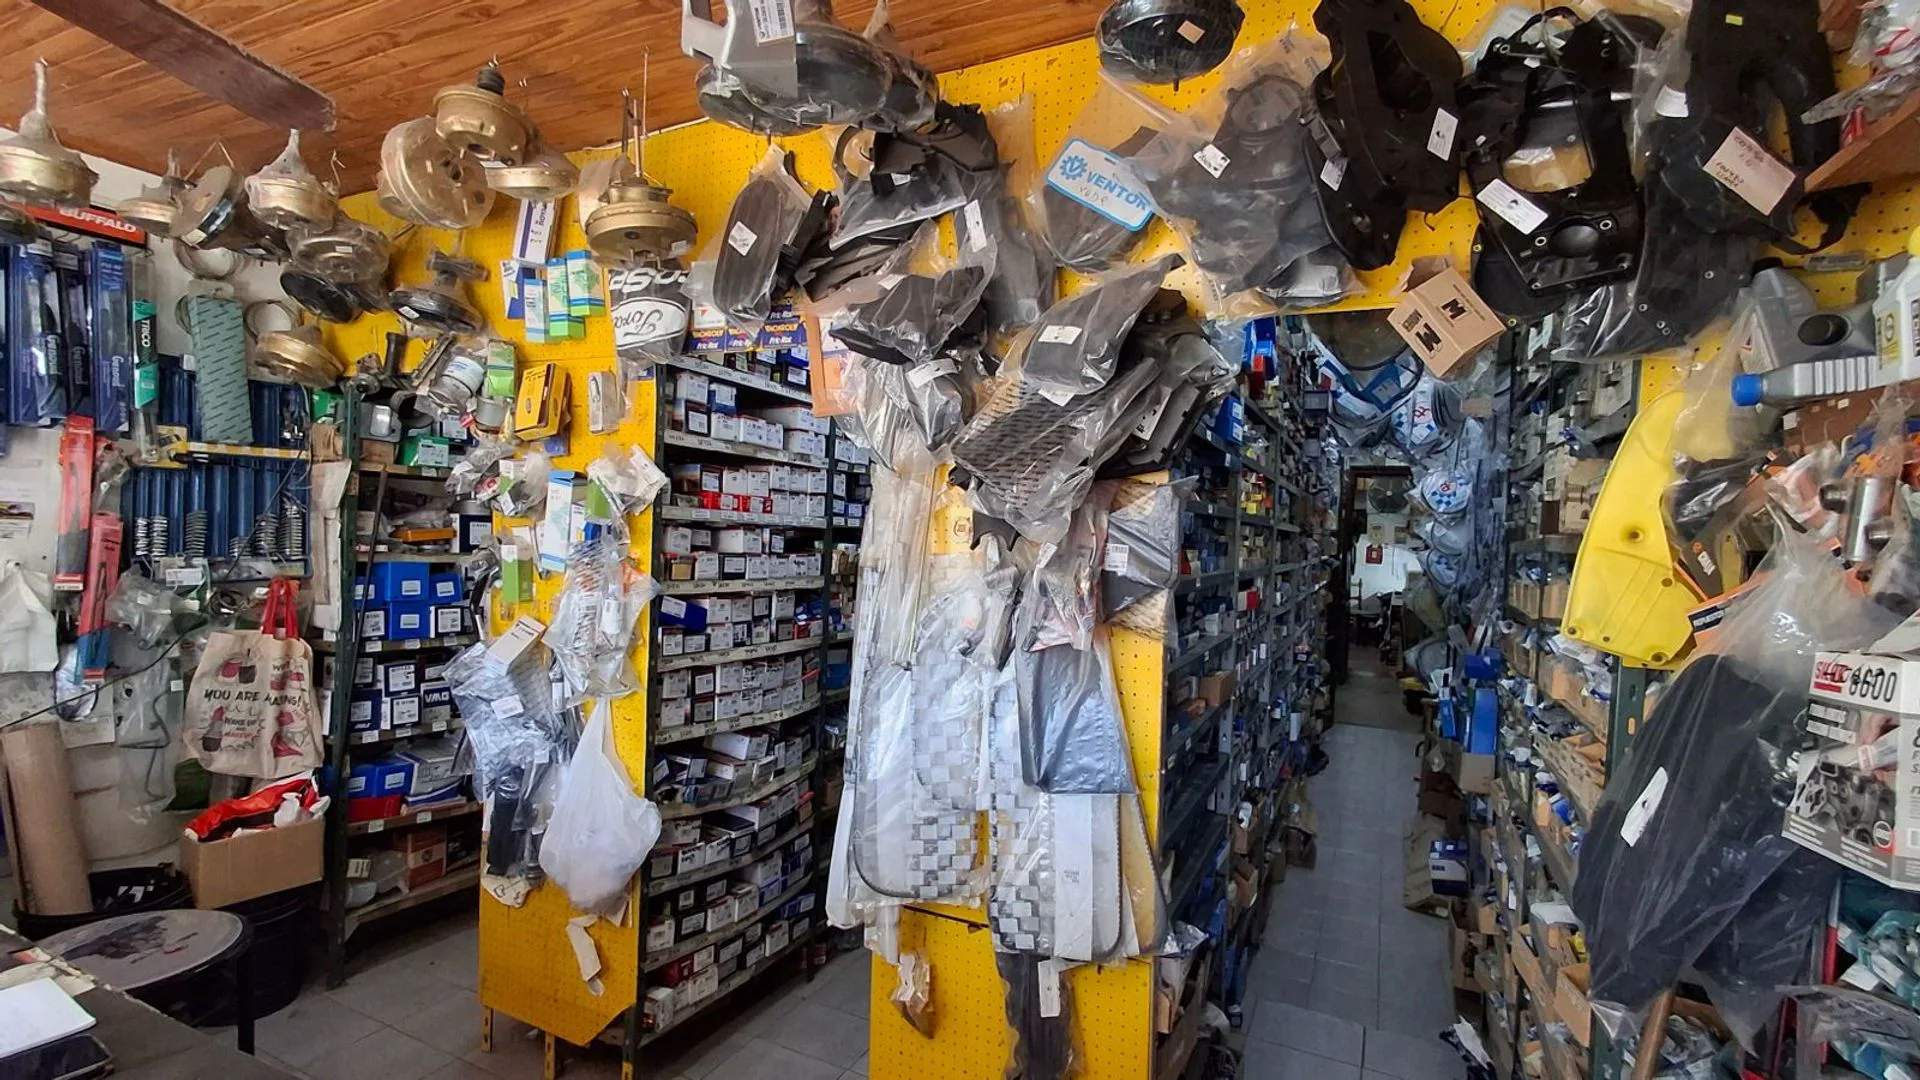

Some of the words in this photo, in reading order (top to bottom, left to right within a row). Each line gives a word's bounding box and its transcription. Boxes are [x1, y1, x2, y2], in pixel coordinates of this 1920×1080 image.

[141, 319, 151, 347] TRICO
[204, 689, 231, 702] YOU
[235, 691, 260, 702] ARE
